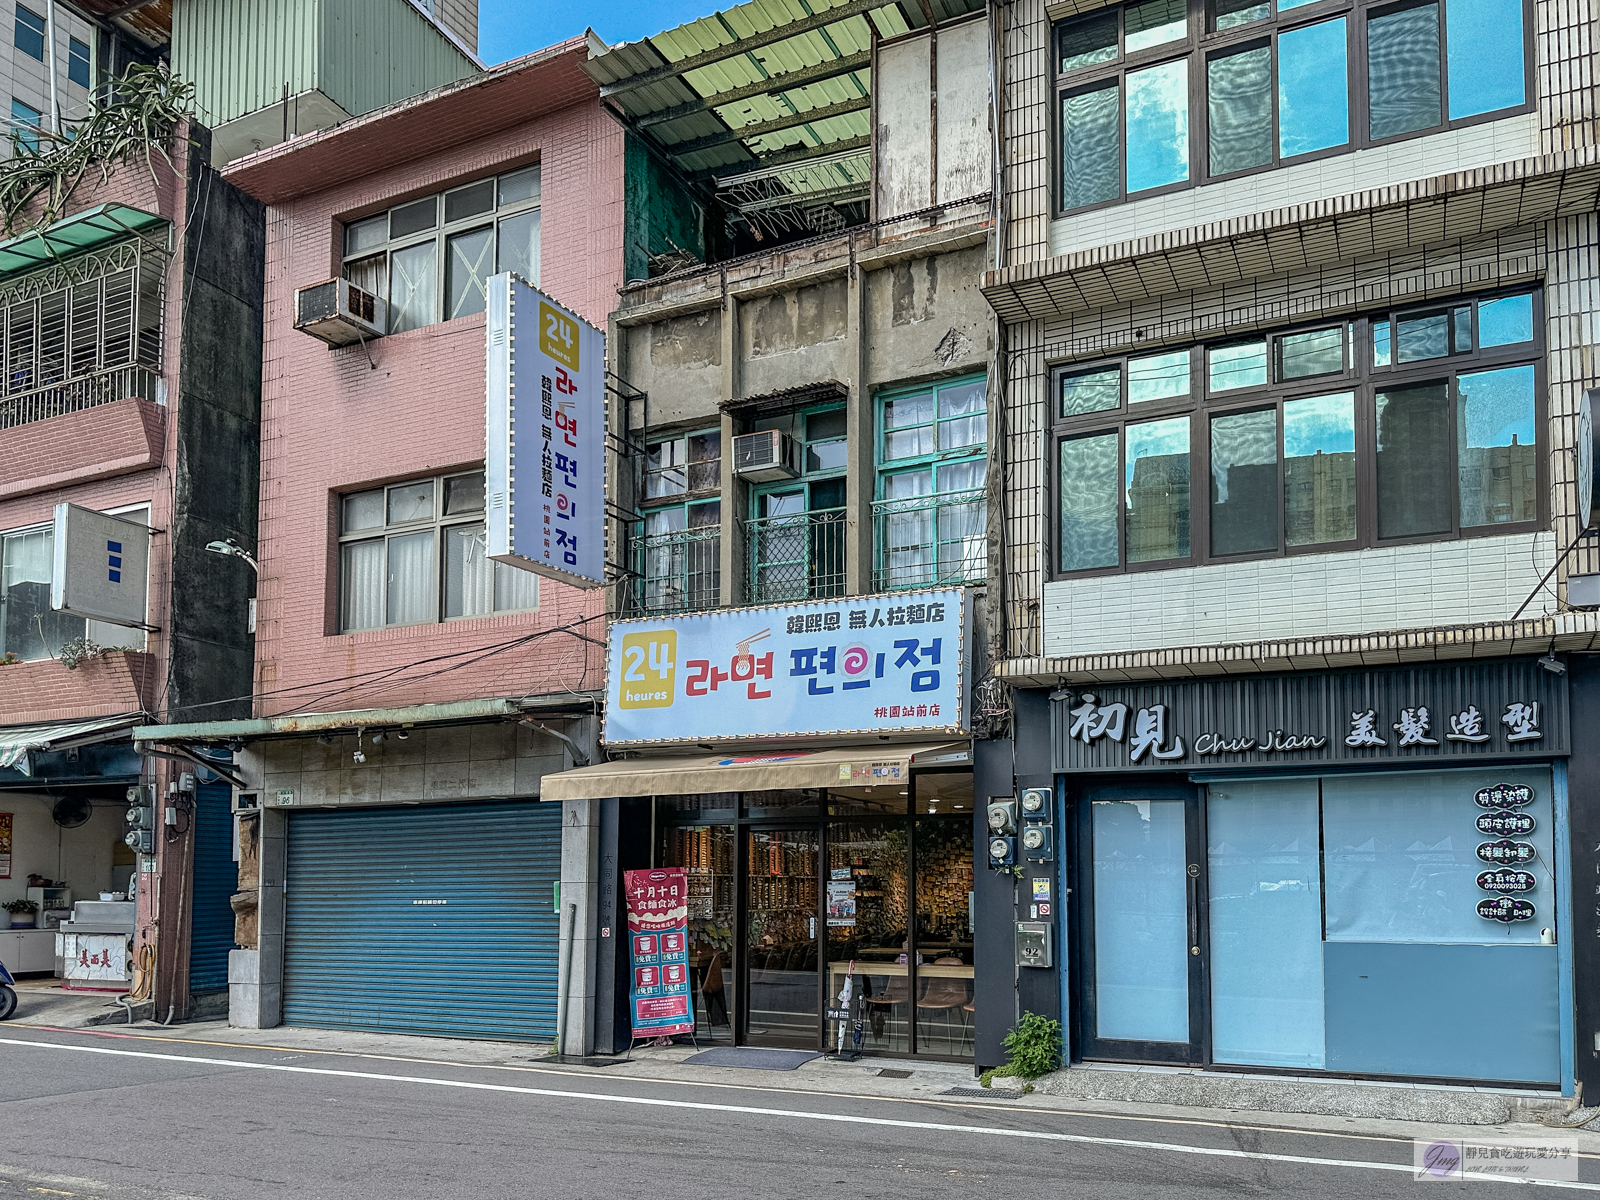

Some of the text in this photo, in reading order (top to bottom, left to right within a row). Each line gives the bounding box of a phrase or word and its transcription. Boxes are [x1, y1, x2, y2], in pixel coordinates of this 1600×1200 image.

[545, 313, 574, 349] 24
[547, 341, 571, 363] heures
[541, 374, 552, 498] 韓熙恩 無人拉麵店
[786, 602, 945, 634] 韓熙恩 無人拉麵店
[624, 641, 673, 682] 24
[626, 689, 667, 702] heures
[874, 703, 941, 719] 桃園站前店
[1069, 692, 1185, 763] 初見
[1344, 700, 1544, 747] 美髮造型
[1194, 729, 1326, 755] Chu Jian
[840, 766, 851, 775] 24
[281, 796, 291, 804] 96
[1478, 817, 1530, 830] 頭皮護理
[1484, 873, 1527, 884] 全身按摩
[1484, 882, 1527, 890] 0920093028
[633, 885, 678, 899] 十月十日
[1025, 947, 1039, 956] 92
